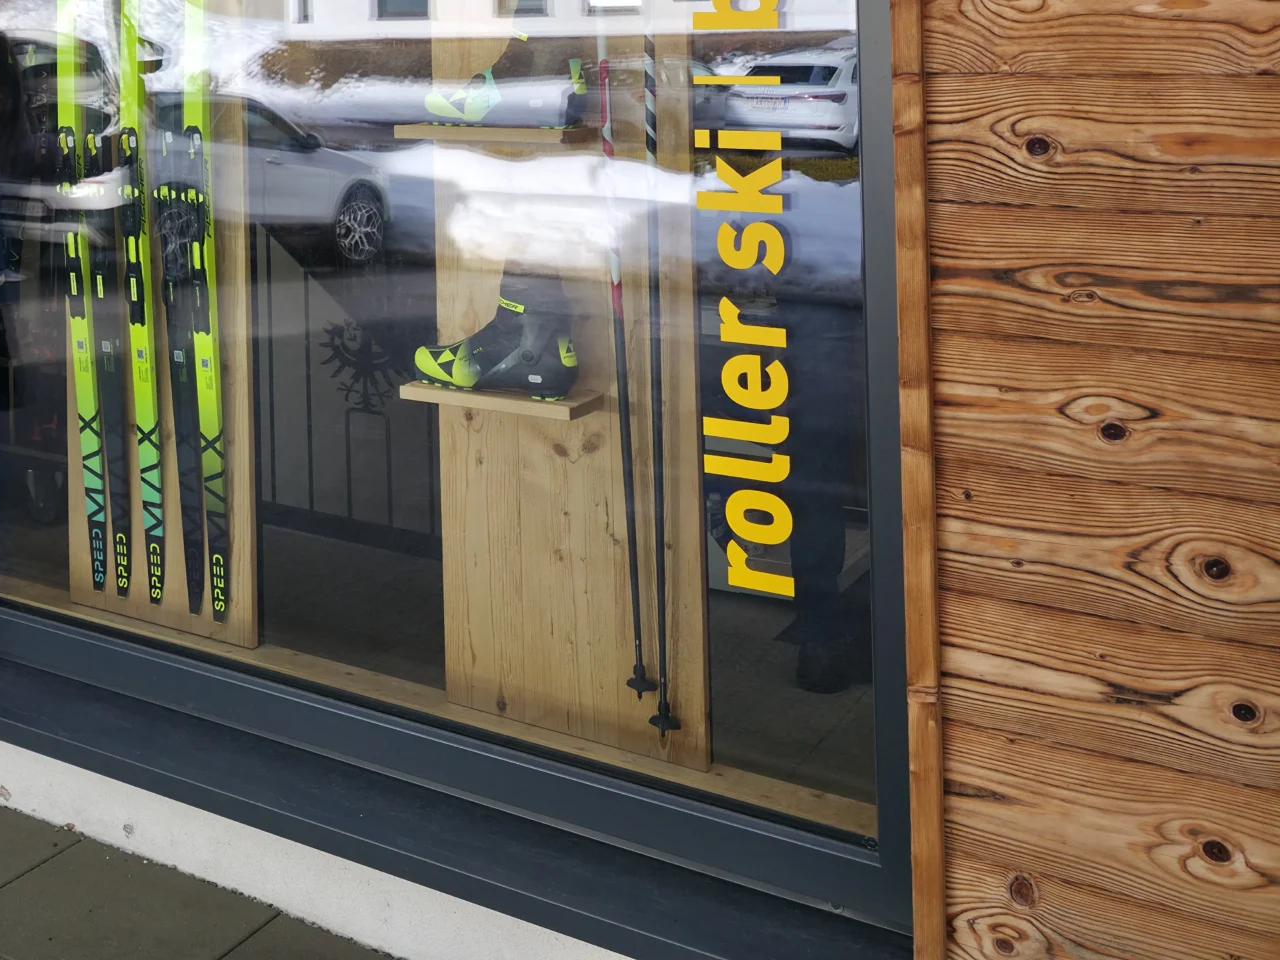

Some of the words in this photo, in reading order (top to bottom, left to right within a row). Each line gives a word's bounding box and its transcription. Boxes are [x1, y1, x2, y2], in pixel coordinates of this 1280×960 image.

[694, 129, 786, 276] ski
[702, 295, 795, 598] roller
[91, 528, 104, 583] SPEED
[116, 533, 128, 588] SPEED
[150, 543, 161, 599] SPEED
[212, 553, 225, 612] SPEED
